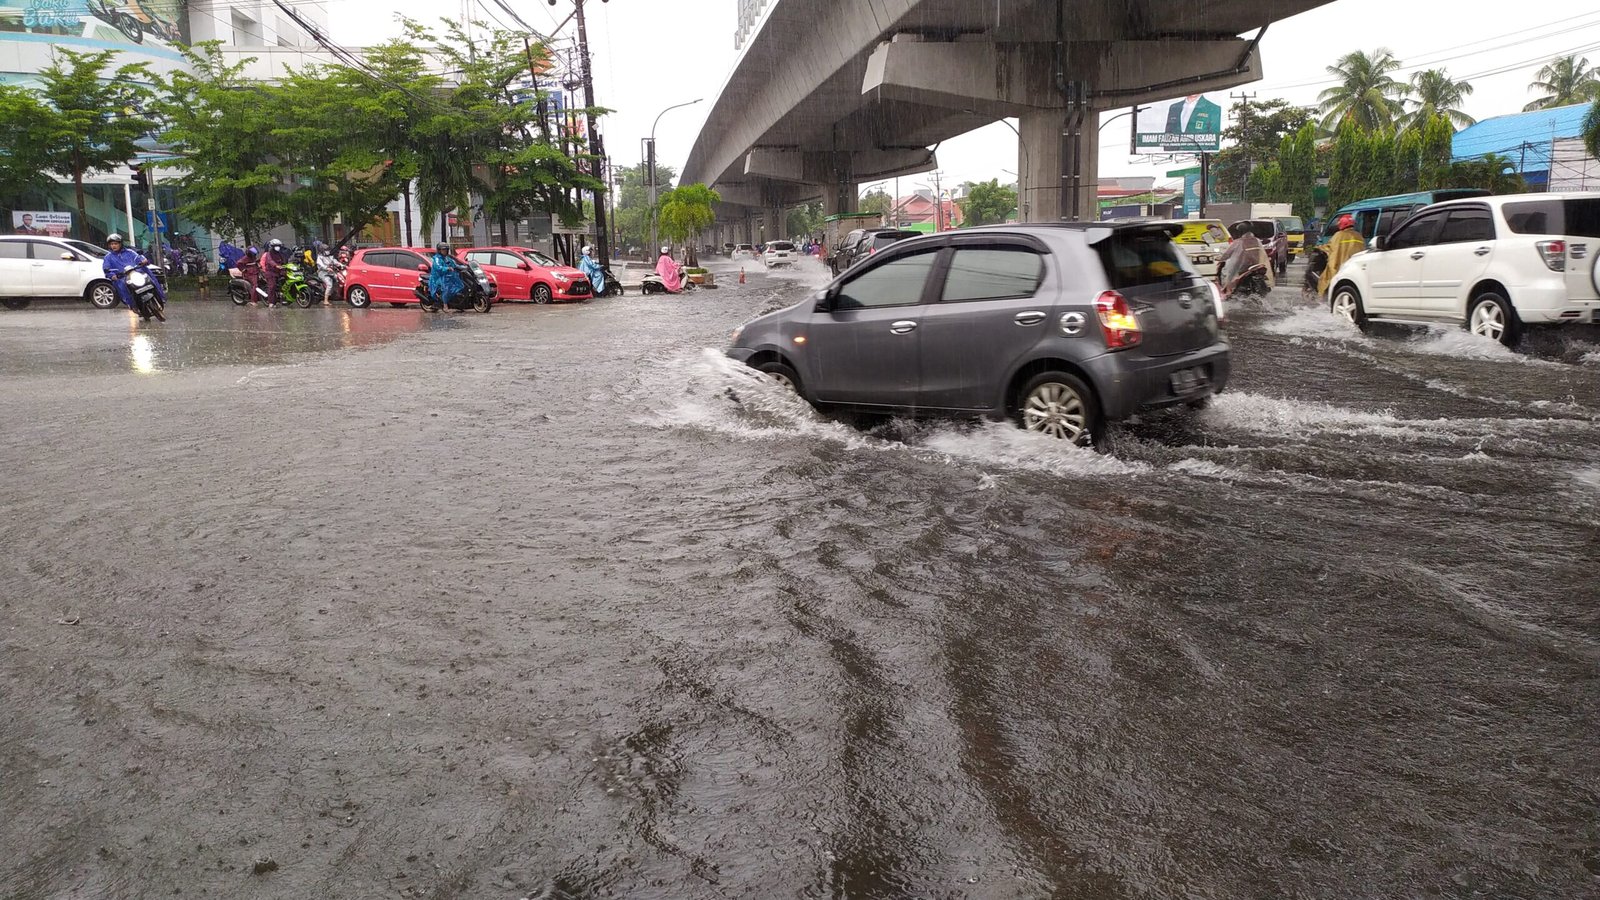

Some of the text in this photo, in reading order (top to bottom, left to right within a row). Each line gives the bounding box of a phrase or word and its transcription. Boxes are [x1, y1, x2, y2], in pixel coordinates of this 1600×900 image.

[522, 80, 558, 88] SUZUKI
[1142, 134, 1158, 143] IMAM
[1195, 133, 1217, 143] USKARA
